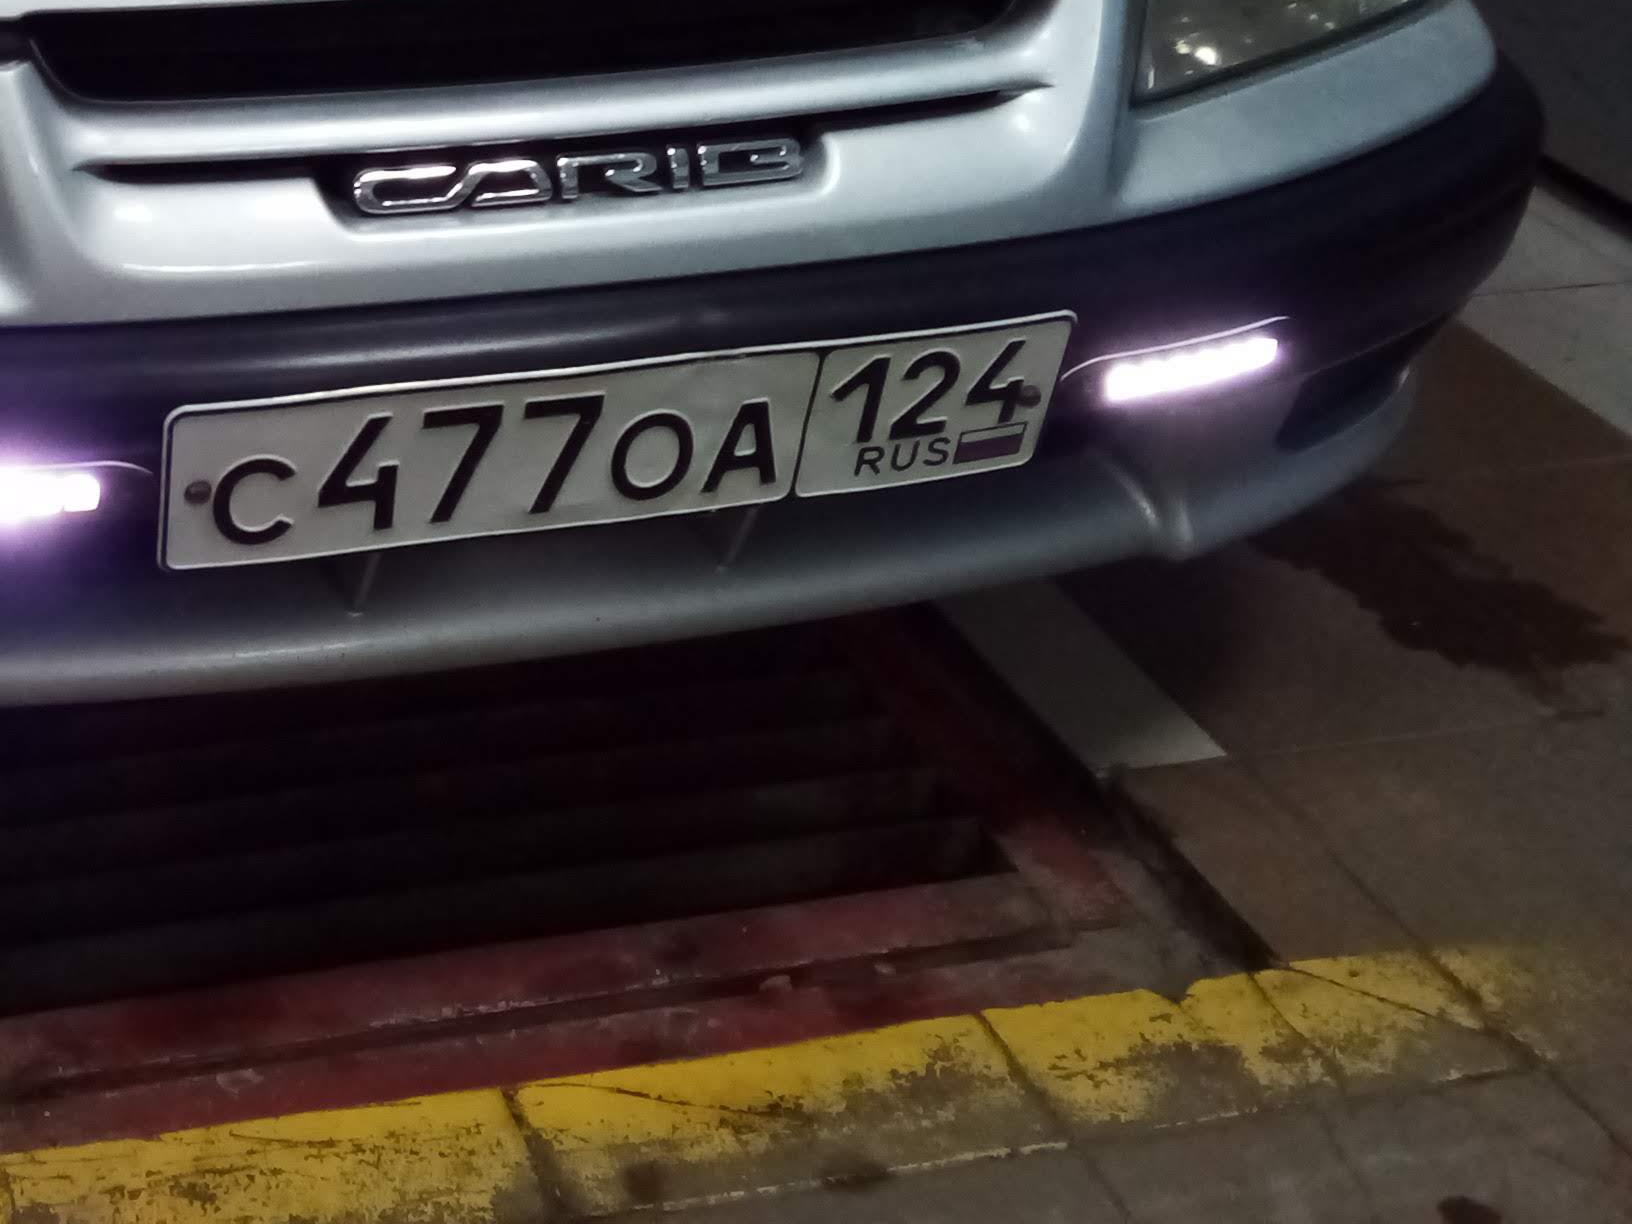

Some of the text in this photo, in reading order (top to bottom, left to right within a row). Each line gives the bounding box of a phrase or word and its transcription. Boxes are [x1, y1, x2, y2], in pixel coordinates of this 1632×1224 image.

[353, 137, 804, 214] CARIB
[830, 339, 1029, 444] 124
[853, 435, 951, 477] RUS
